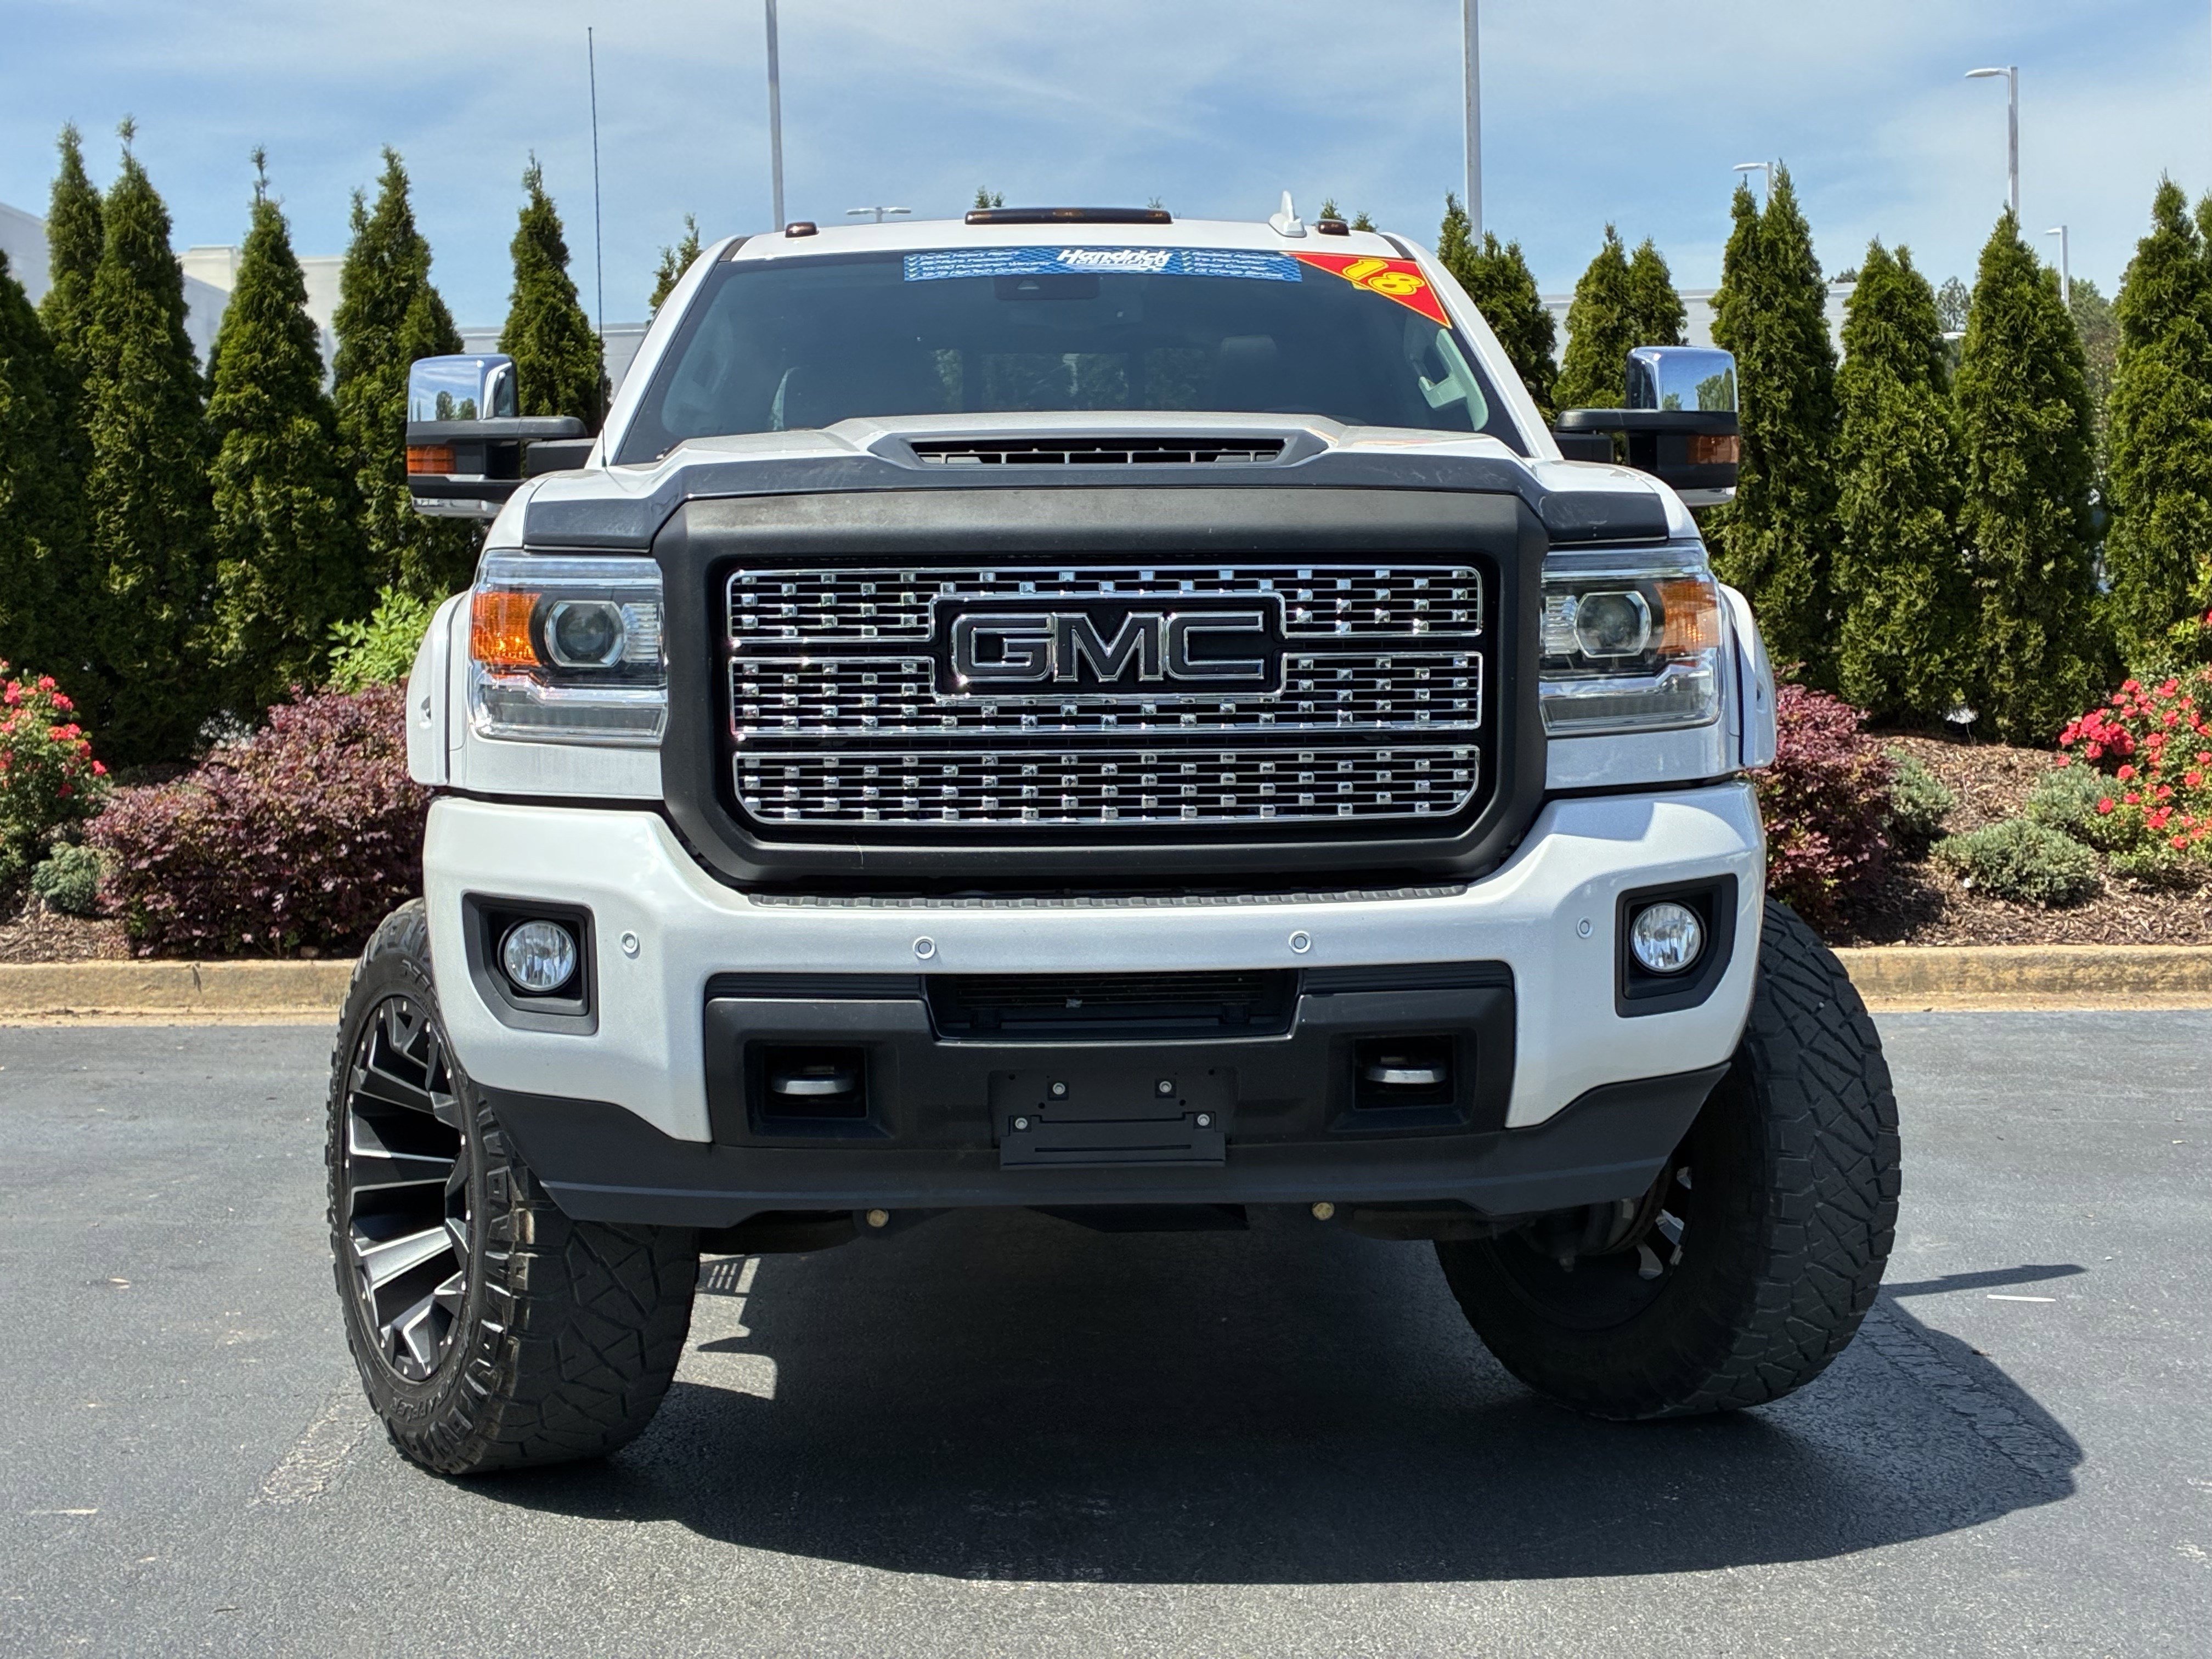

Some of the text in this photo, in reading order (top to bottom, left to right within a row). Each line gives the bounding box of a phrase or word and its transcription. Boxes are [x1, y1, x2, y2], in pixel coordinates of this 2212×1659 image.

[1056, 250, 1173, 264] Hendrick
[1342, 259, 1425, 295] 18
[951, 611, 1265, 682] GMC
